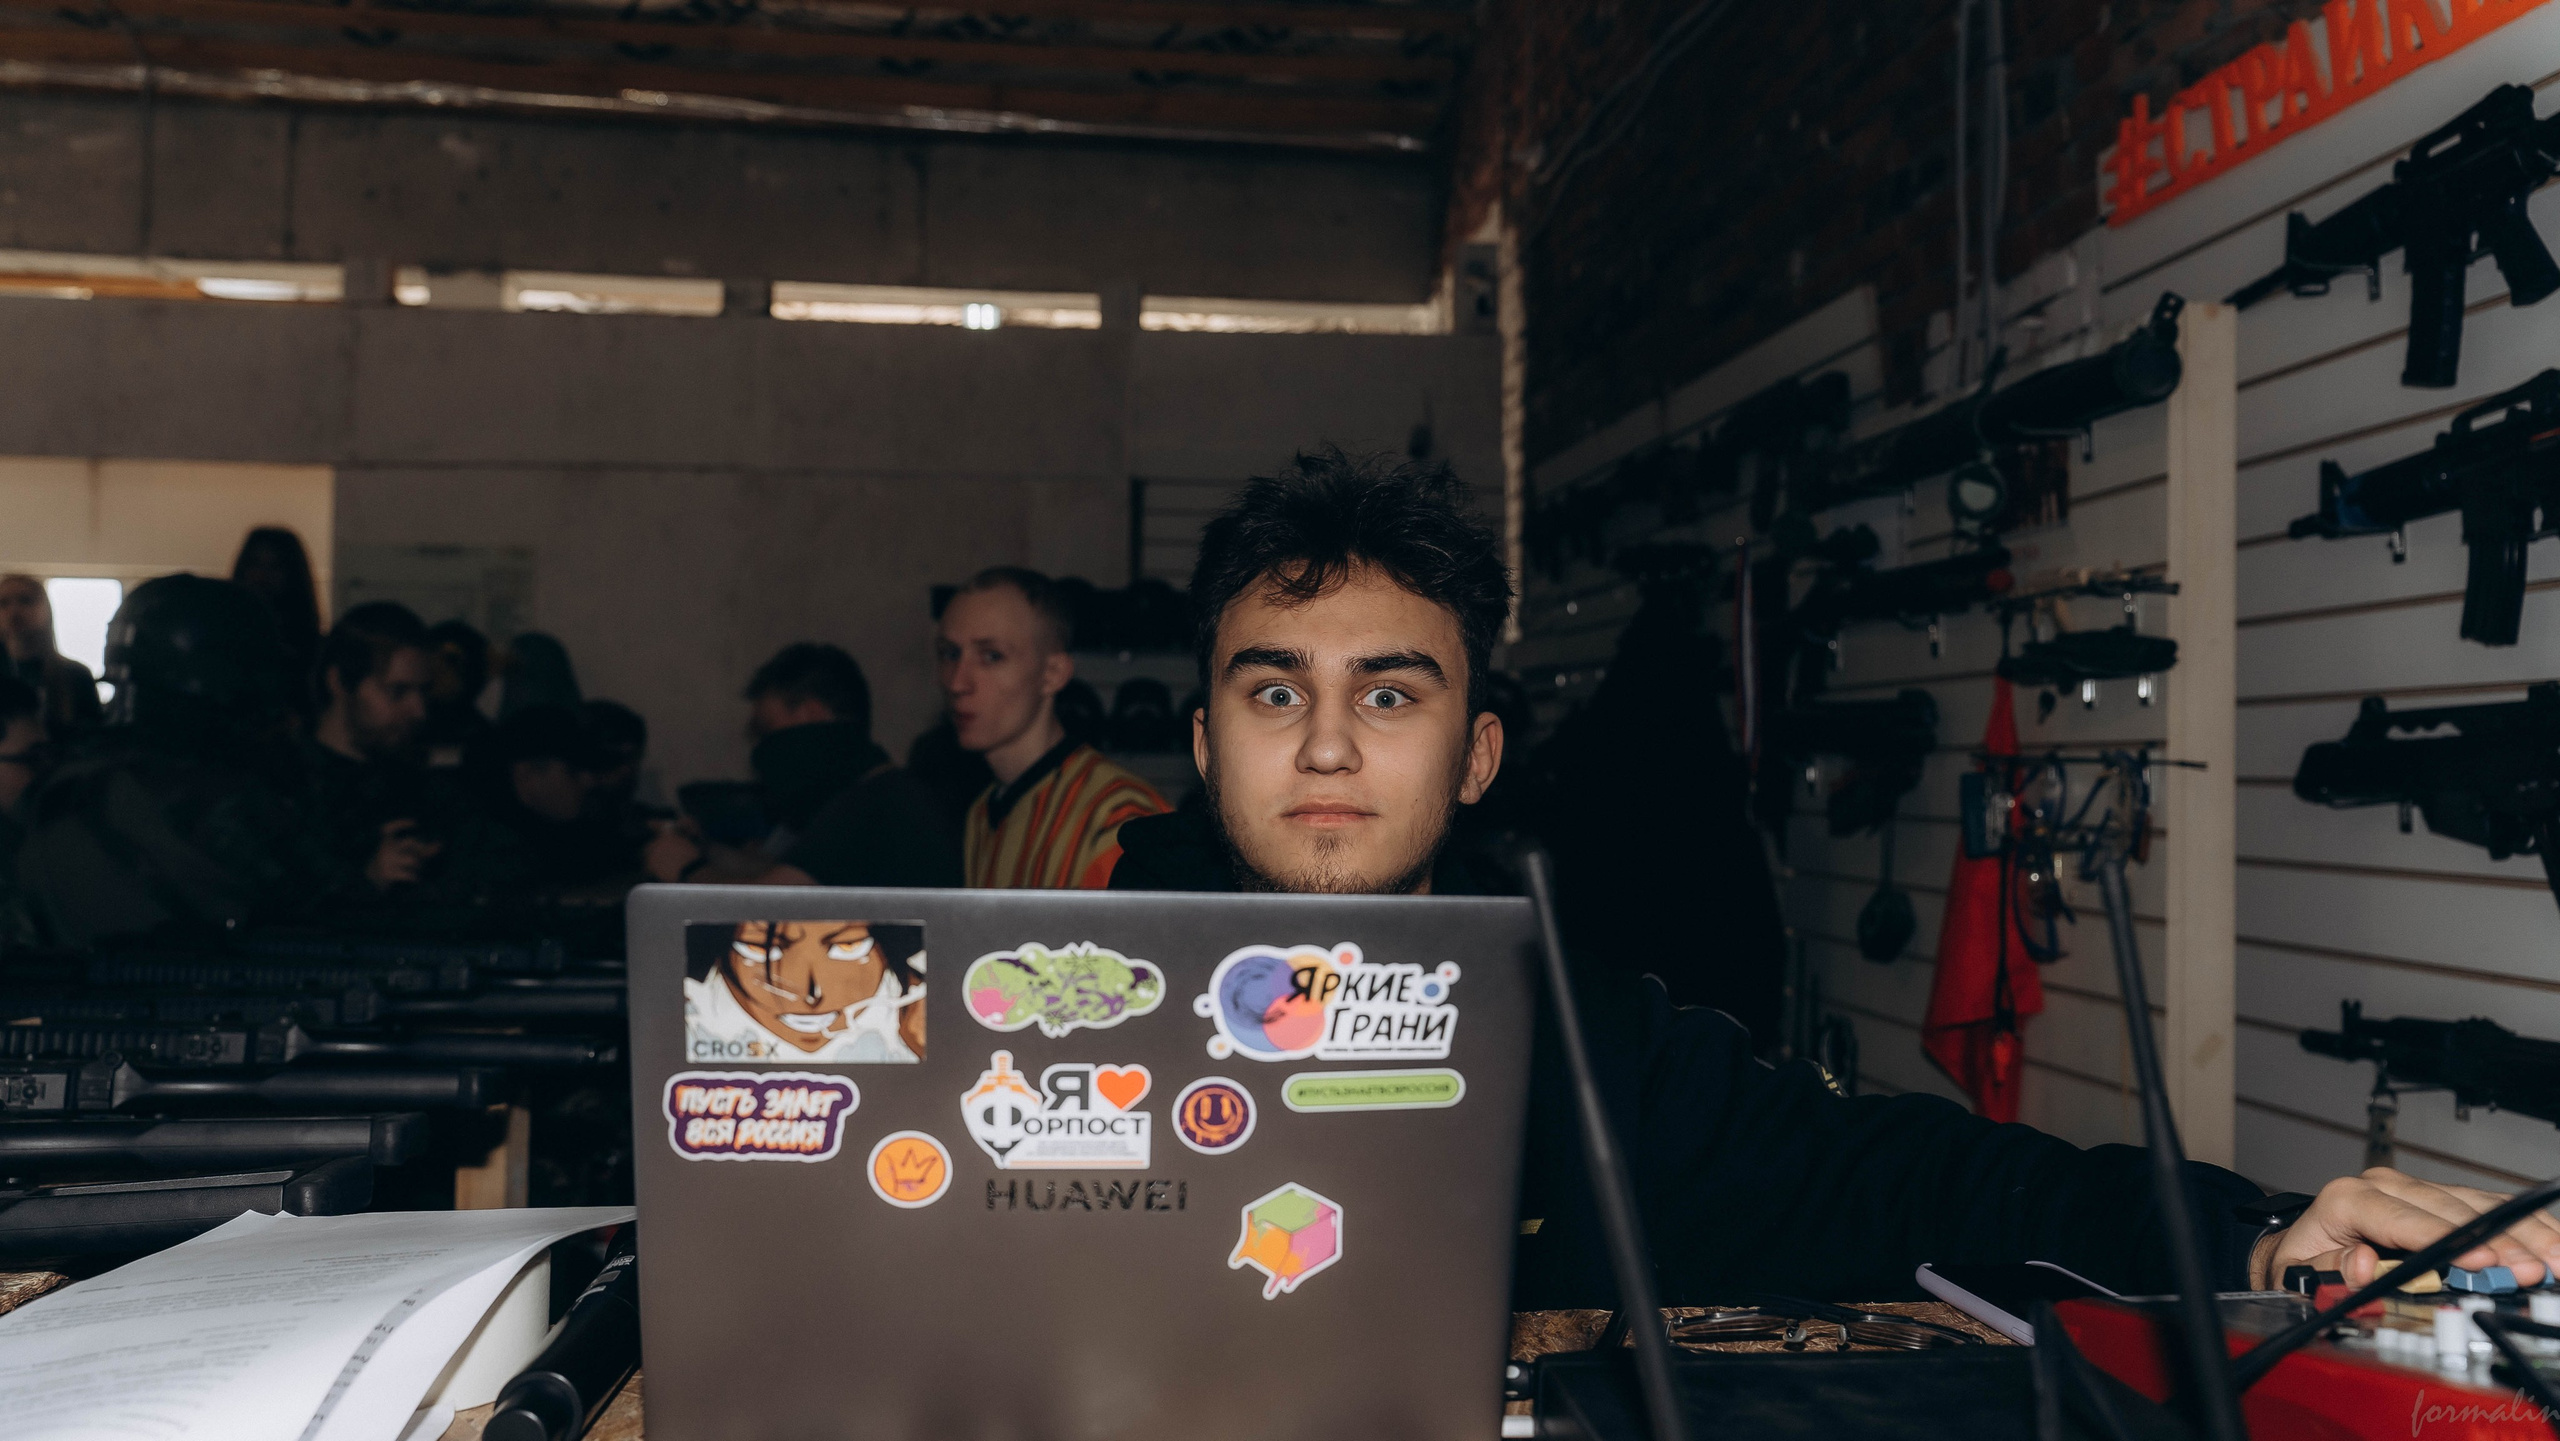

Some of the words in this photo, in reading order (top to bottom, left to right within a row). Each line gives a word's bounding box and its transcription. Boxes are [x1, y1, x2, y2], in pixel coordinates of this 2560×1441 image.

[1286, 966, 1414, 1003] ЯРКИЕ
[1329, 1008, 1451, 1043] ГРАНИ
[675, 1084, 758, 1118] ПУСТЬ
[1047, 1070, 1090, 1111] Я
[685, 1117, 737, 1149] ВСЯ
[733, 1118, 828, 1153] РОССИЯ
[983, 1104, 1145, 1148] ФОРПОСТ
[986, 1178, 1188, 1212] HUAWEI
